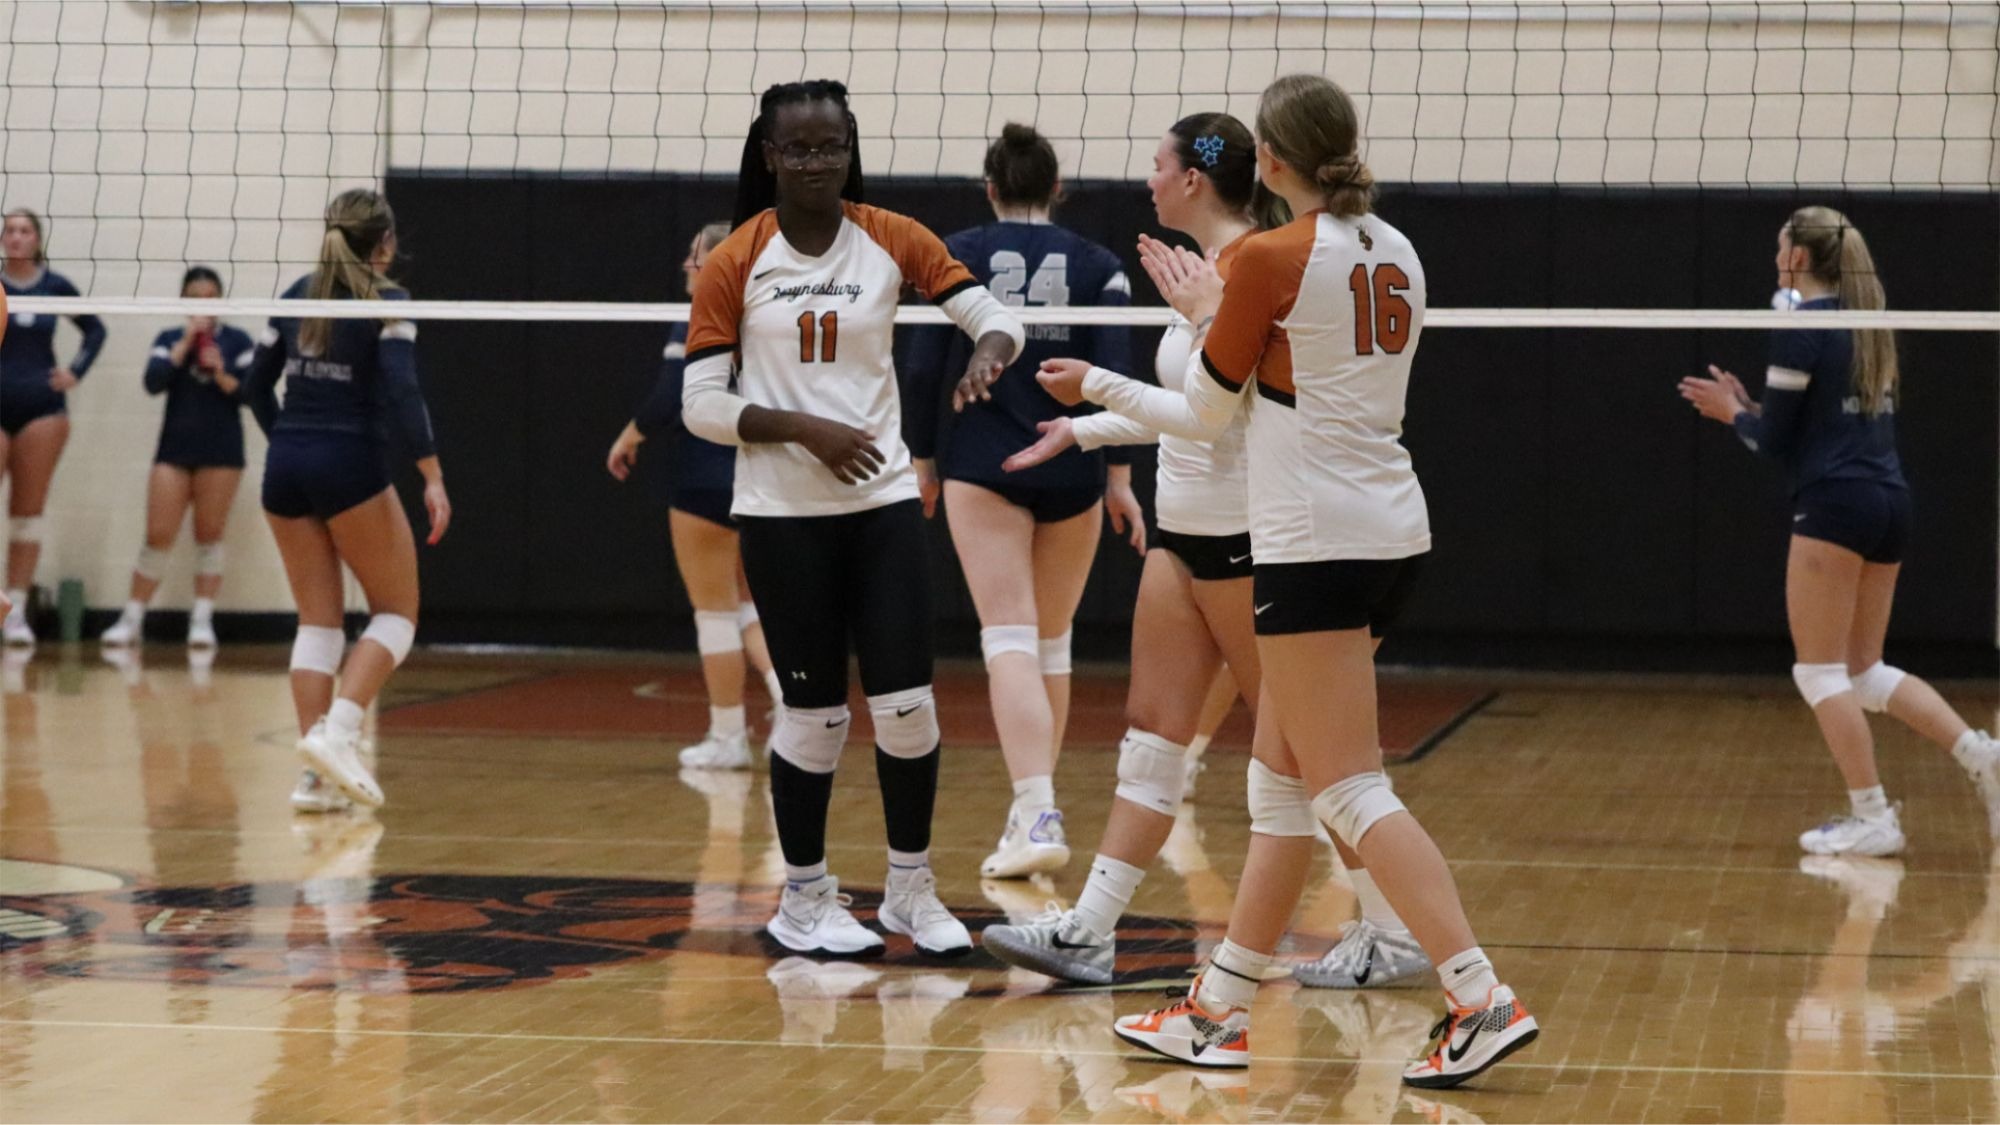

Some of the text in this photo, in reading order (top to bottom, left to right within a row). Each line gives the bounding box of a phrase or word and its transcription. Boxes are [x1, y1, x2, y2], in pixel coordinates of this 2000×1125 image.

[772, 277, 863, 304] ynesburg
[989, 250, 1070, 307] 24
[797, 310, 838, 363] 11
[1349, 263, 1412, 355] 16
